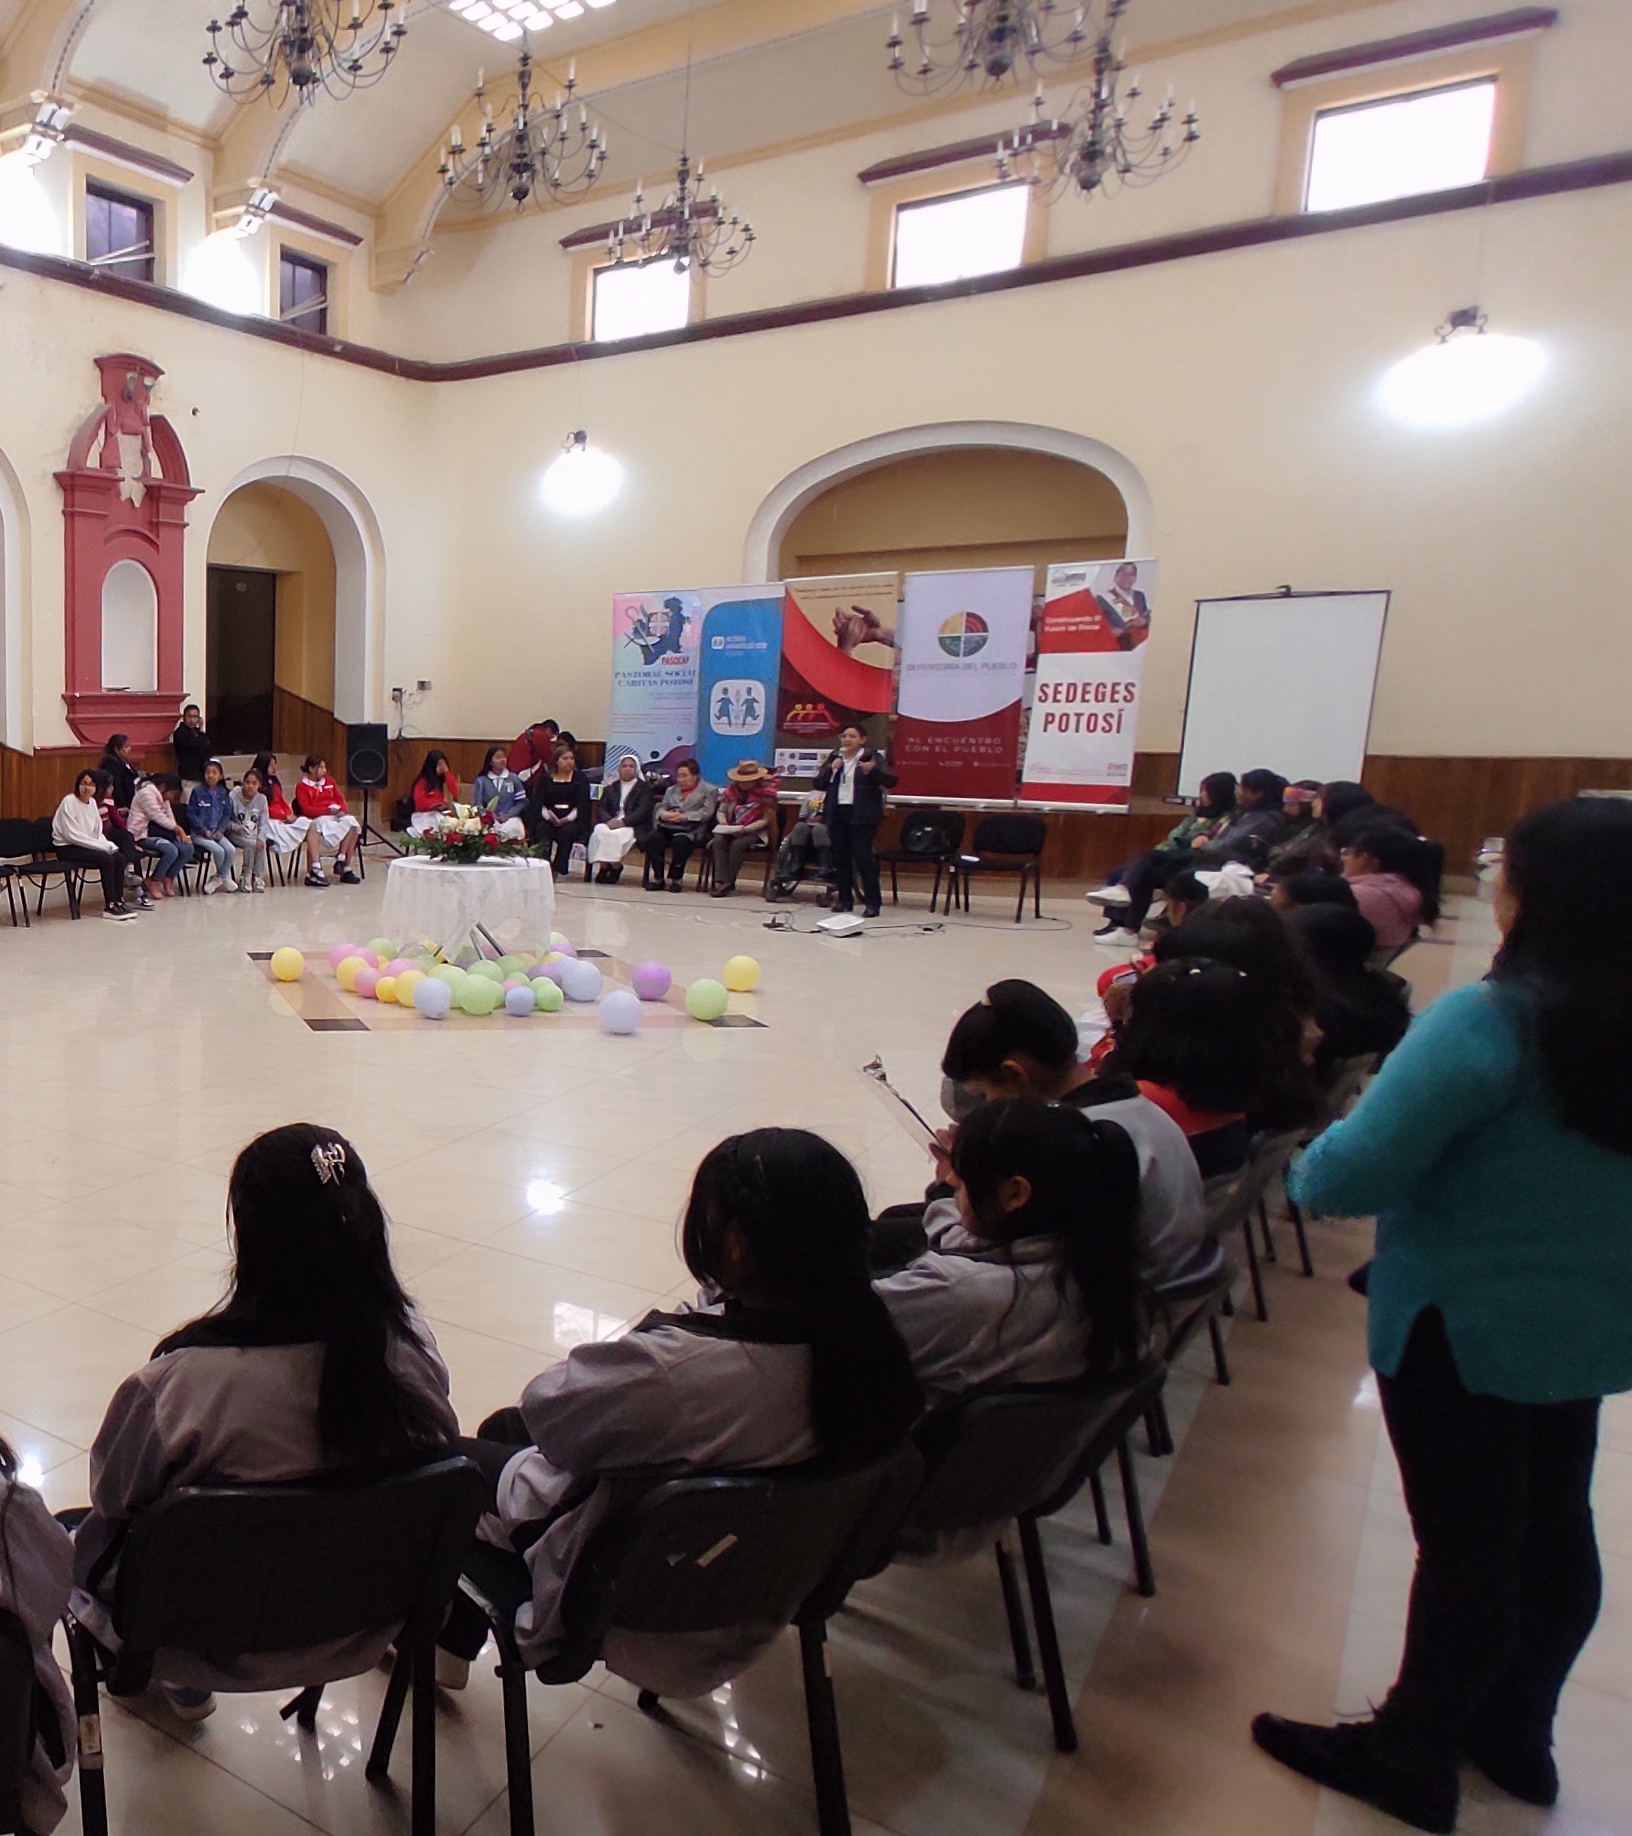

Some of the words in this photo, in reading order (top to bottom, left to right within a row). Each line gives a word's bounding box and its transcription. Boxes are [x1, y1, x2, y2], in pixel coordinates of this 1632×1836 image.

[981, 662, 1017, 670] PUEBLO
[1038, 682, 1136, 703] SEDEGES
[1043, 708, 1125, 734] POTOSÍ
[927, 736, 1001, 744] ENCUENTRO
